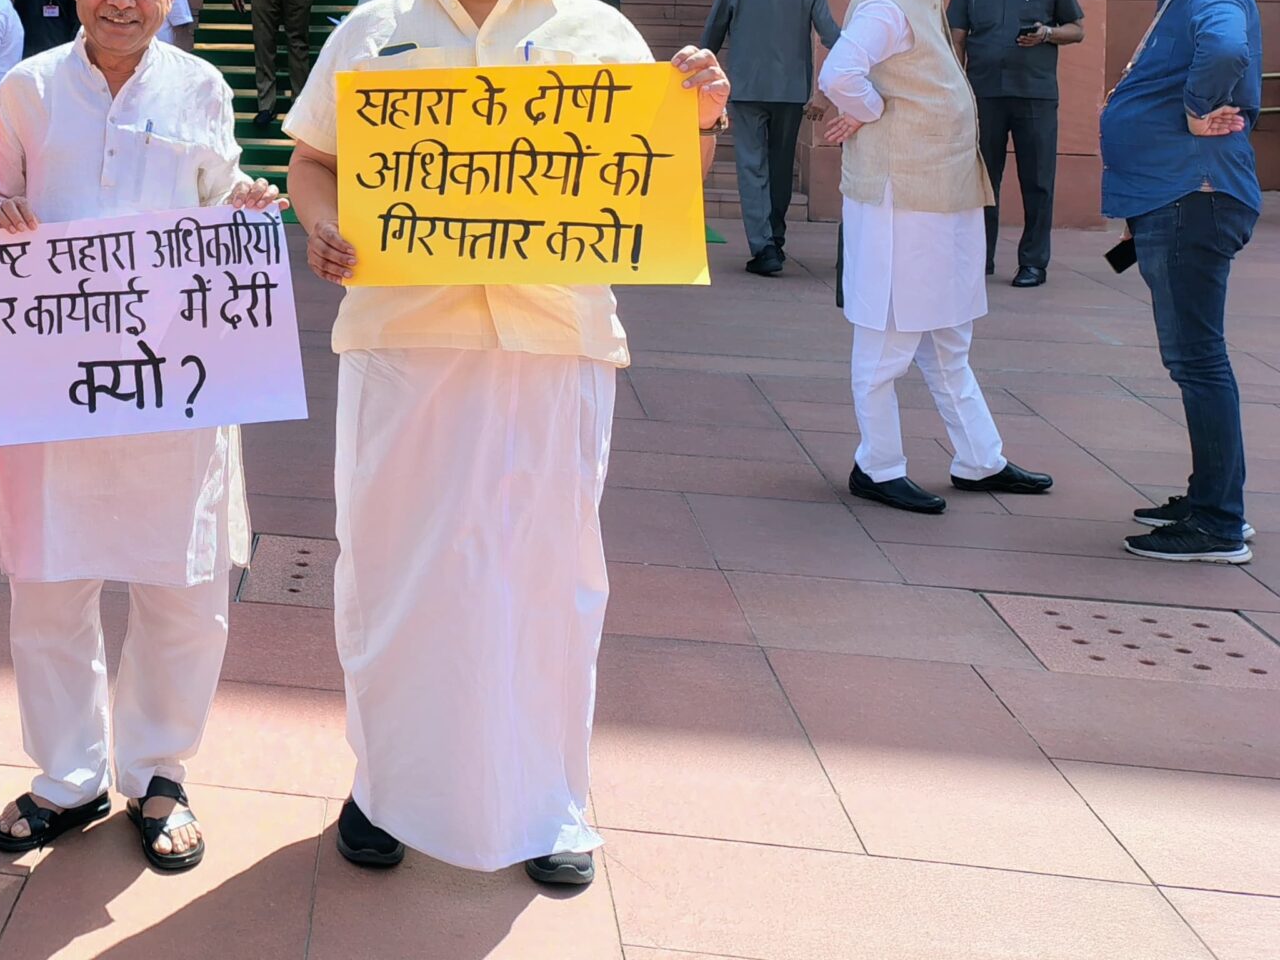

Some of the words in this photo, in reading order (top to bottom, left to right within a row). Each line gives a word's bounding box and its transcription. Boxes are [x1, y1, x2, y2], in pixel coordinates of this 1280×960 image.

[355, 88, 467, 130] सहारा
[472, 74, 508, 126] के
[524, 68, 633, 125] दोषी
[356, 131, 601, 197] अधिकारियों
[599, 133, 675, 197] को
[46, 230, 135, 275] सहारा
[147, 209, 282, 269] अधिकारियों
[180, 274, 212, 329] में
[220, 270, 279, 330] देरी
